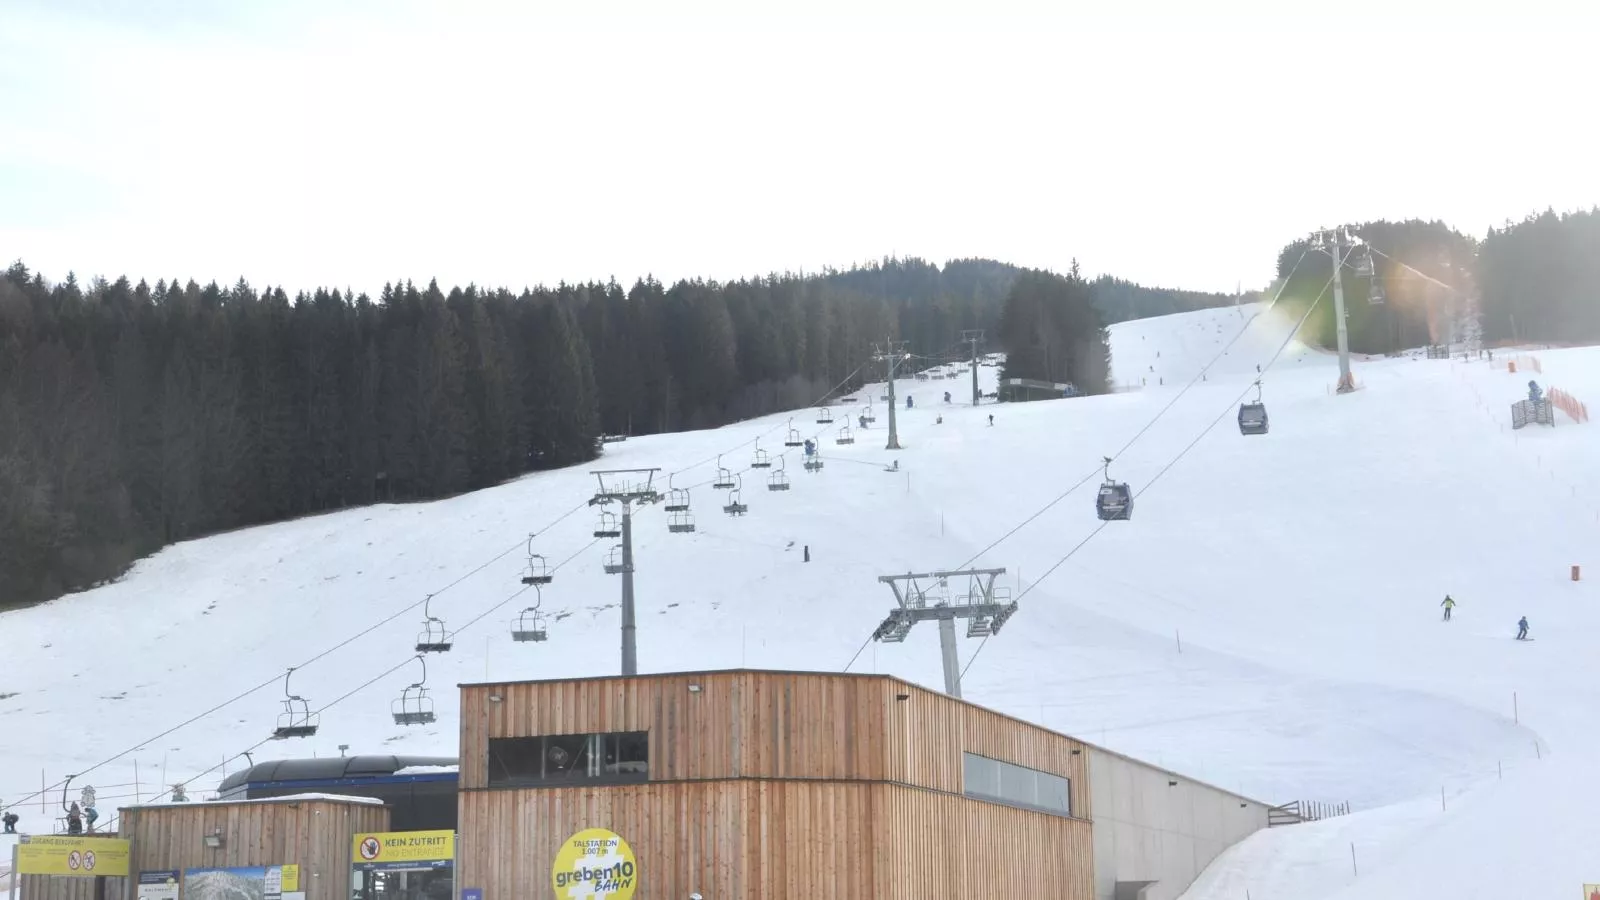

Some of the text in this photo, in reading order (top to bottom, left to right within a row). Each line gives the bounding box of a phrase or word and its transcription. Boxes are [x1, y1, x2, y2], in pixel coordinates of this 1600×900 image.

[385, 837, 447, 847] KEIN ZUTRITT
[385, 849, 399, 858] NO
[582, 847, 600, 855] 1.007
[556, 862, 633, 887] greben10
[594, 878, 632, 892] BAHN
